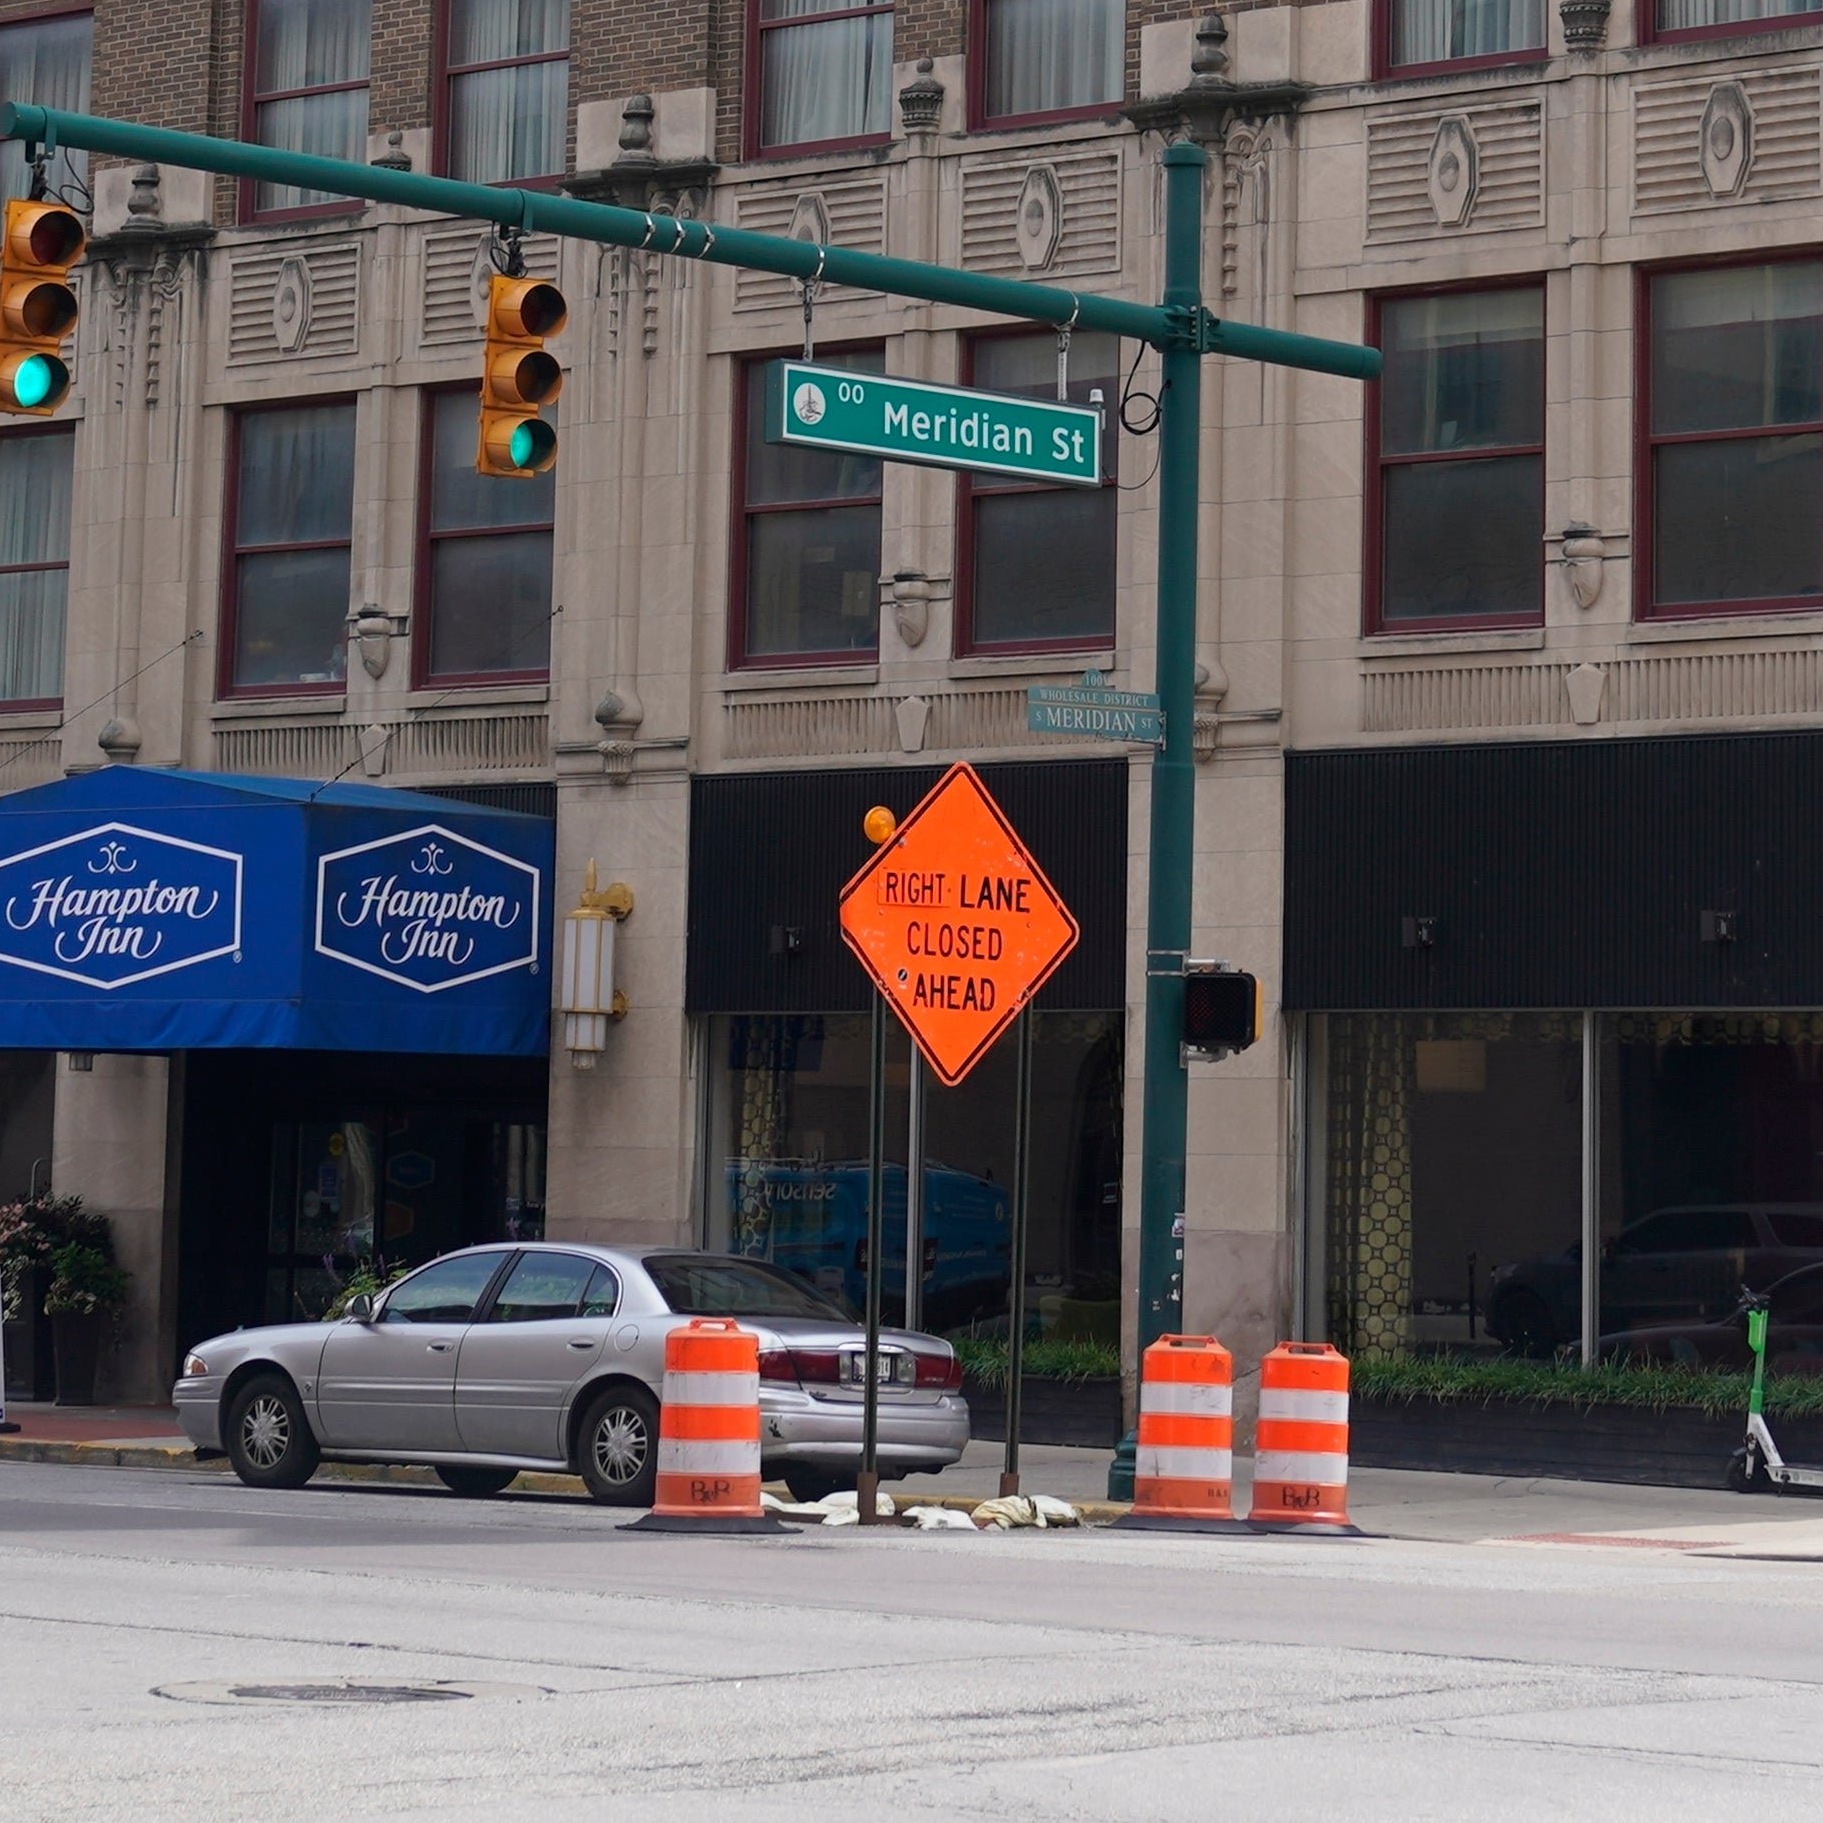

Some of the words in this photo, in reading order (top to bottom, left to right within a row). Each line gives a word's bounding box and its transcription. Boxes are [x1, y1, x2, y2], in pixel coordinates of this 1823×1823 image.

[884, 401, 1033, 456] Meridian
[1052, 427, 1085, 464] St
[1040, 688, 1098, 704] WHOLESALE
[1104, 693, 1149, 707] DISTRICT
[1085, 675, 1103, 686] 100
[1036, 711, 1042, 721] S
[1046, 706, 1136, 731] MERIDIAN
[1142, 718, 1153, 729] ST
[6, 875, 219, 931] Hampton
[337, 874, 520, 929] Hampton
[885, 872, 946, 904] RIGHT
[960, 874, 1031, 913] LANE
[55, 916, 163, 963] Inn
[381, 918, 474, 965] Inn
[907, 921, 1003, 961] CLOSED
[912, 973, 996, 1012] AHEAD
